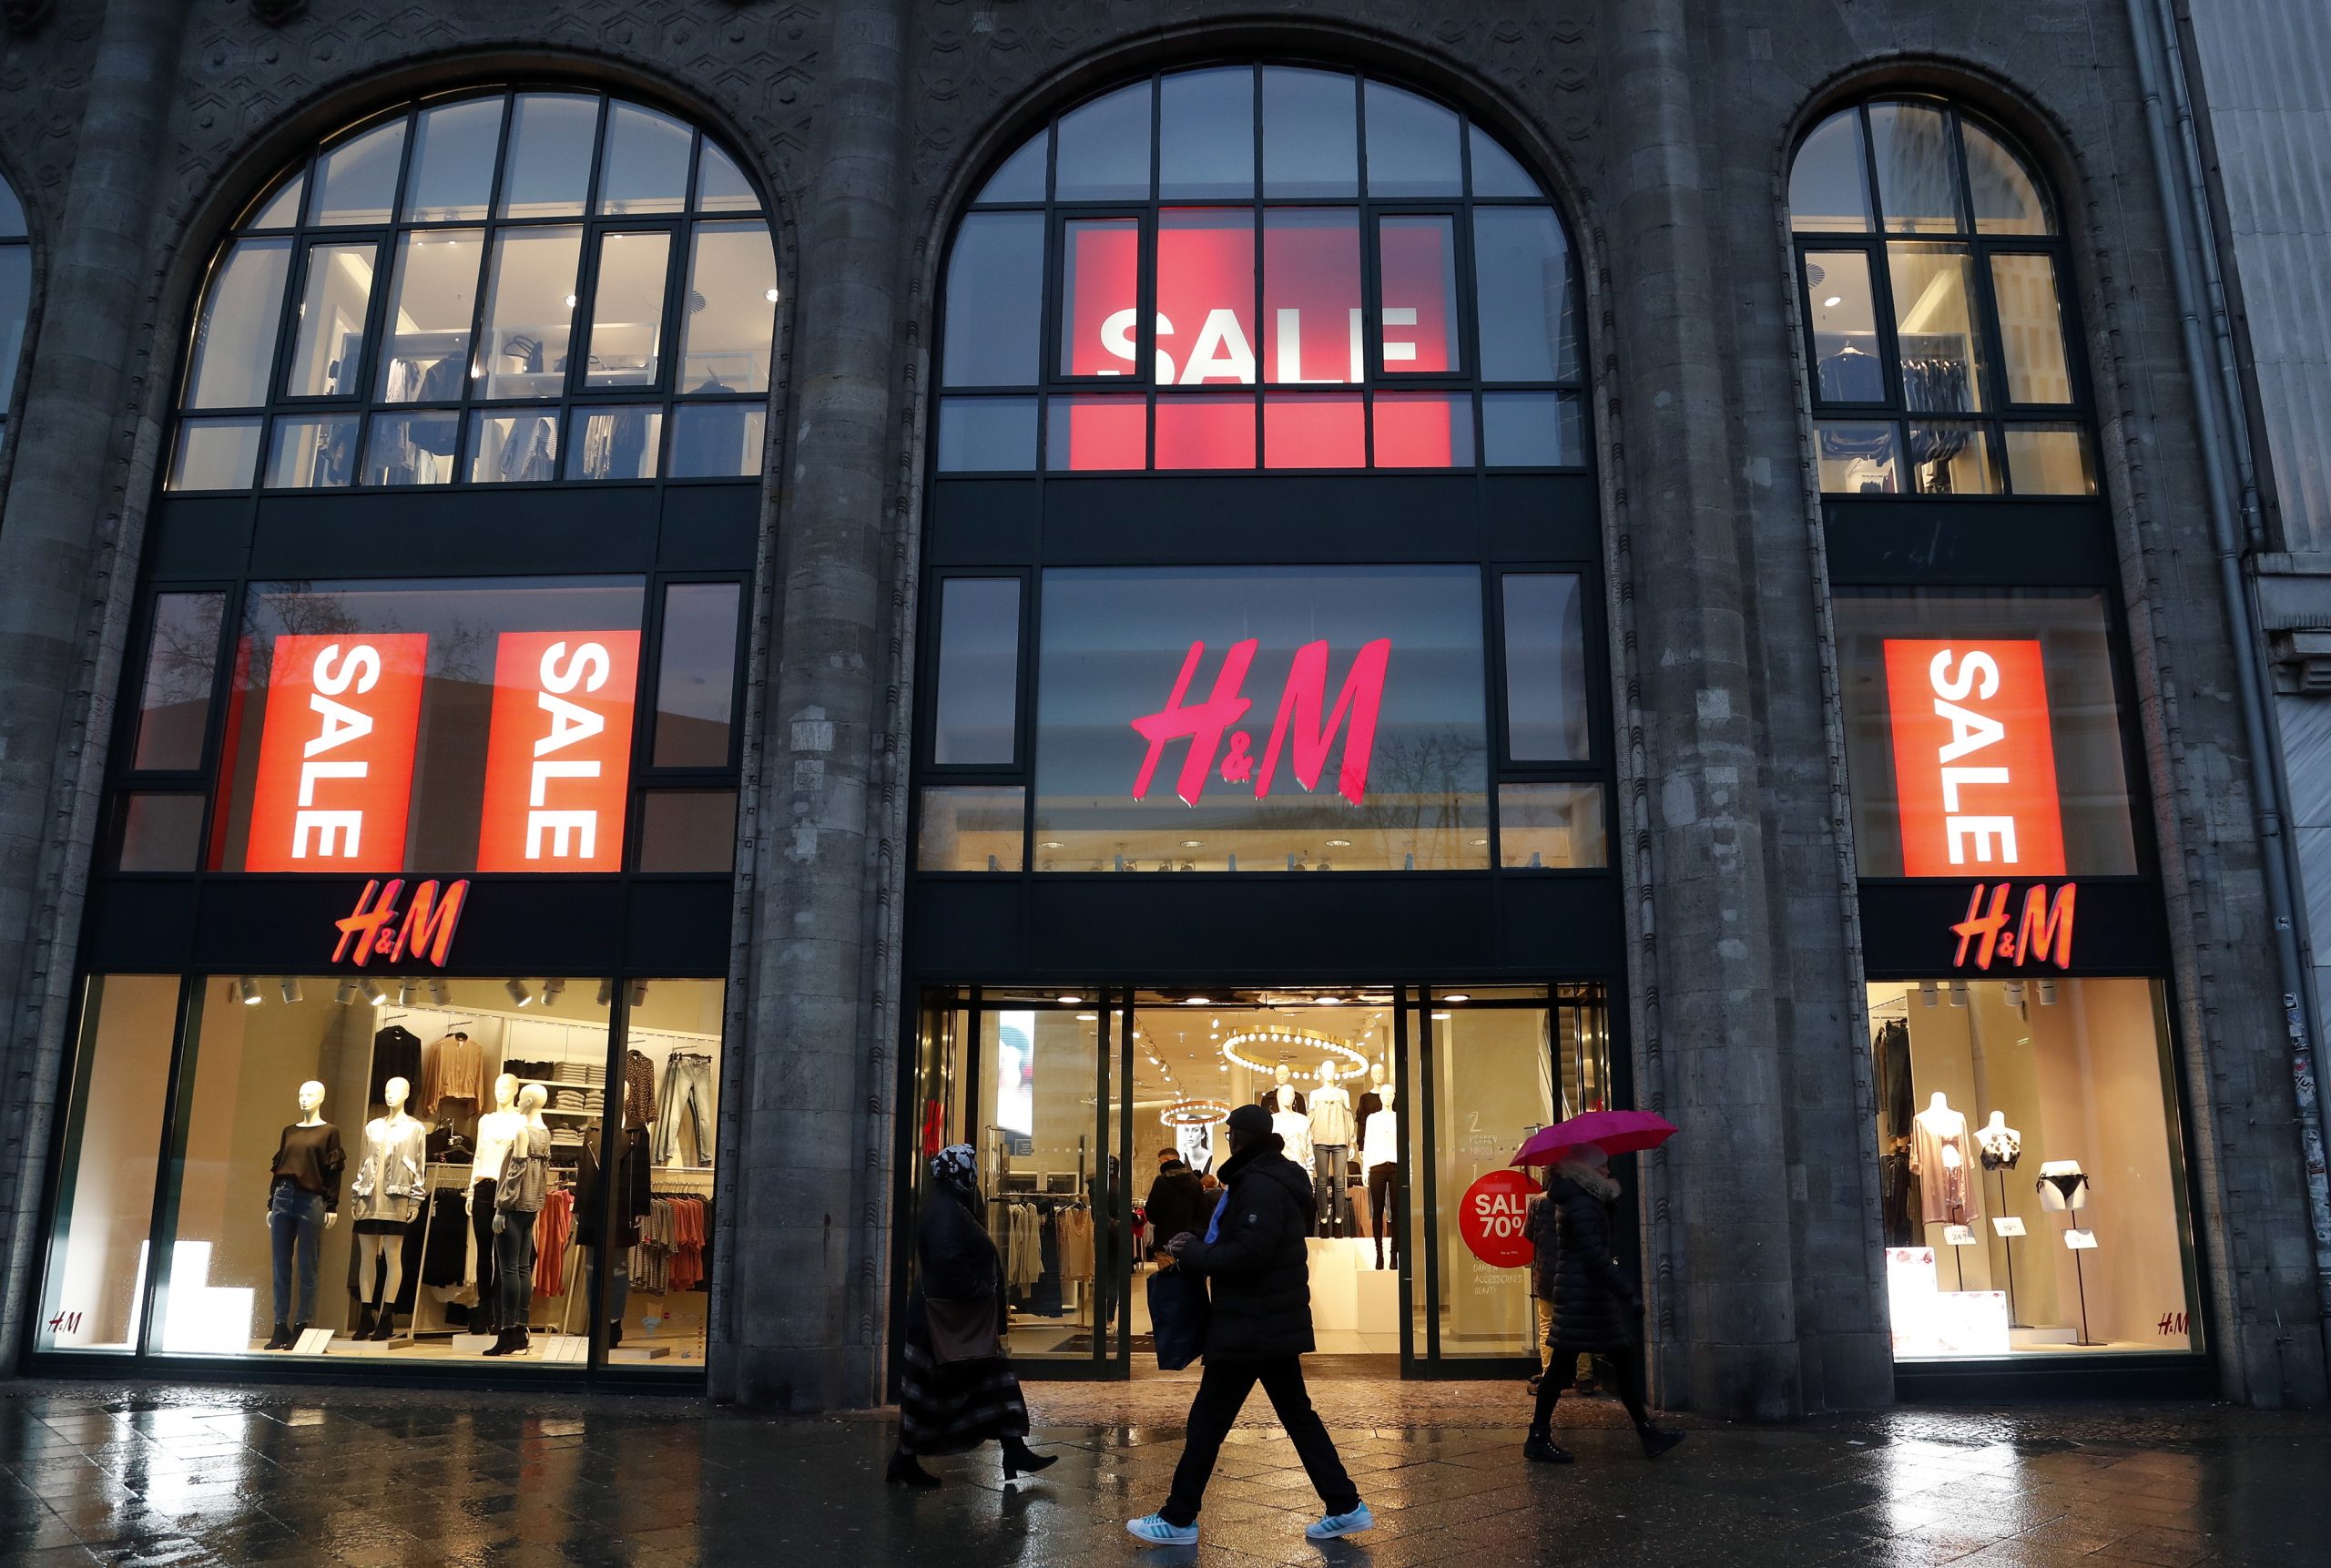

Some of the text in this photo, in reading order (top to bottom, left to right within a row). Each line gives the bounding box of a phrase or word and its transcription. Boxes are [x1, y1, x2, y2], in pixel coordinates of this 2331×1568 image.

[290, 643, 382, 859] SALE
[524, 640, 611, 860] SALE
[1130, 637, 1392, 809] H&M
[1929, 648, 2019, 865] SALE
[331, 878, 471, 968] H&M
[1949, 881, 2077, 971] H&M
[1469, 1111, 1481, 1133] 2
[48, 1310, 83, 1335] H&M
[2157, 1311, 2189, 1336] H&M
